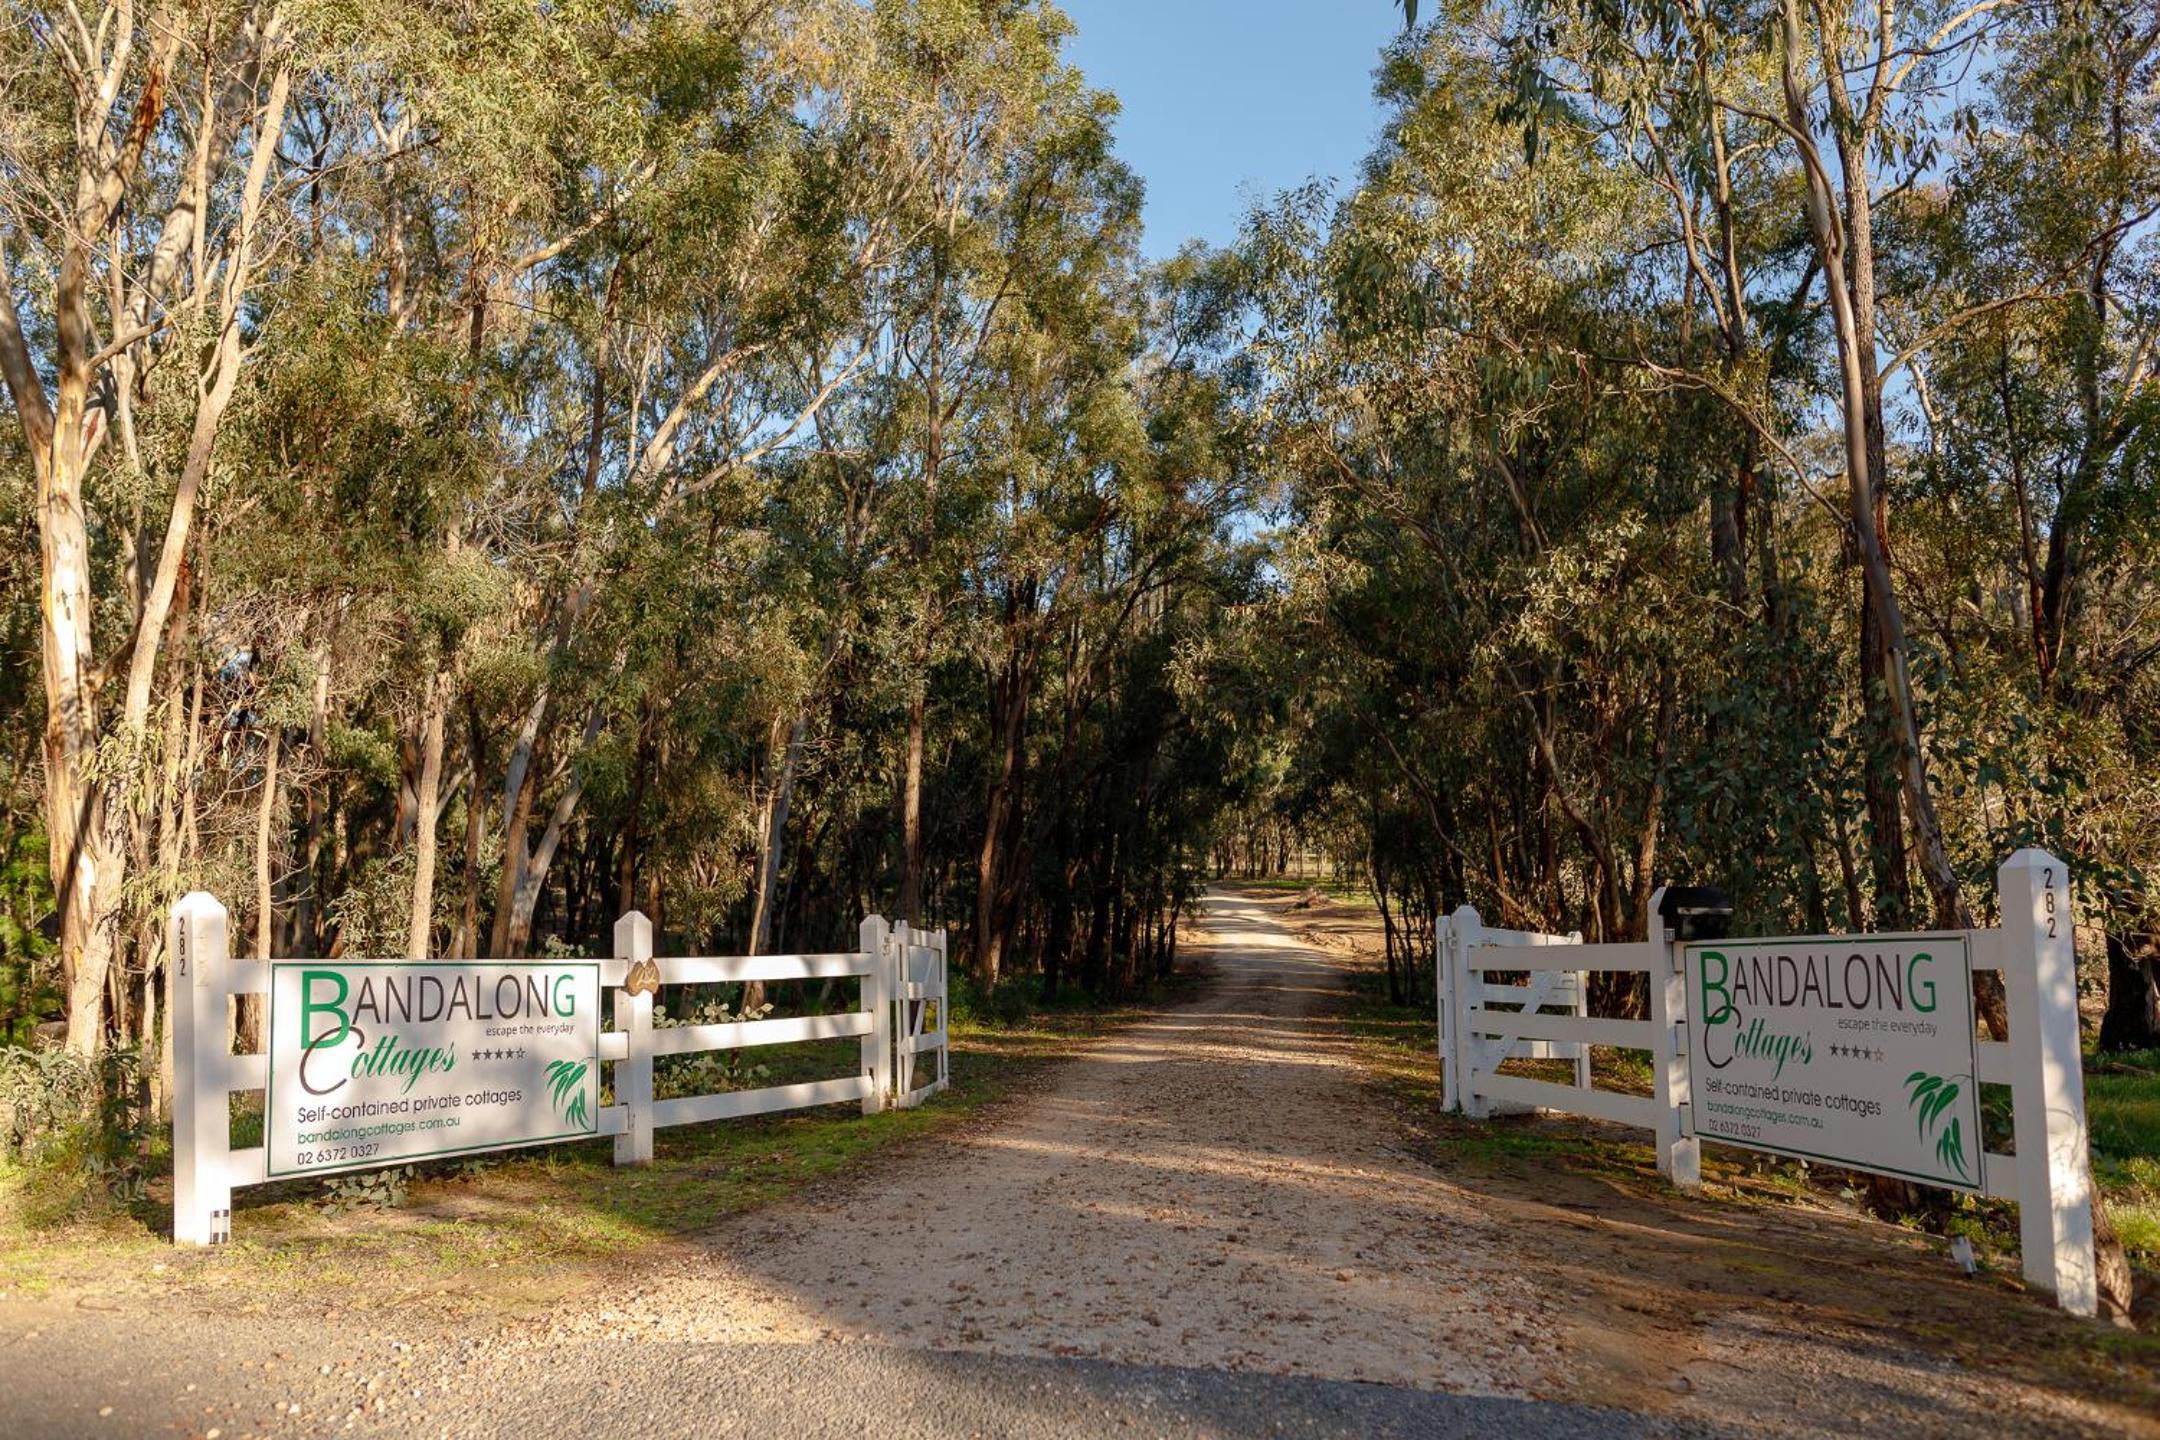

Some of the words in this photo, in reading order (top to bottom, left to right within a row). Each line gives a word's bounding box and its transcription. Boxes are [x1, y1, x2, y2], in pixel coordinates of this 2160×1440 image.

[2043, 867, 2056, 938] 282
[1700, 951, 1937, 1025] BANDALONG
[301, 970, 575, 1050] BANDALONG
[1838, 1018, 1869, 1032] escape
[1871, 1018, 1888, 1032] the
[1890, 1020, 1938, 1038] everyday
[486, 1025, 517, 1038] escape
[519, 1023, 534, 1034] the
[536, 1021, 575, 1037] everyday
[1704, 1005, 1813, 1081] Cottages
[299, 1026, 459, 1095] Cottages
[297, 1096, 409, 1124] Self-contained
[413, 1094, 461, 1112] private
[465, 1088, 522, 1106] cottages
[1706, 1077, 1779, 1101] Self-contained
[1782, 1087, 1821, 1107] private
[1825, 1093, 1882, 1117] cottages
[298, 1114, 461, 1144] bandalongcottages.com.au
[1707, 1102, 1824, 1129] bandalongcottages.com.au
[1708, 1118, 1718, 1131] 02
[1720, 1120, 1739, 1135] 6372
[1741, 1123, 1761, 1138] 0327
[297, 1152, 312, 1165] 02
[317, 1147, 346, 1161] 6372
[351, 1143, 379, 1158] 0327
